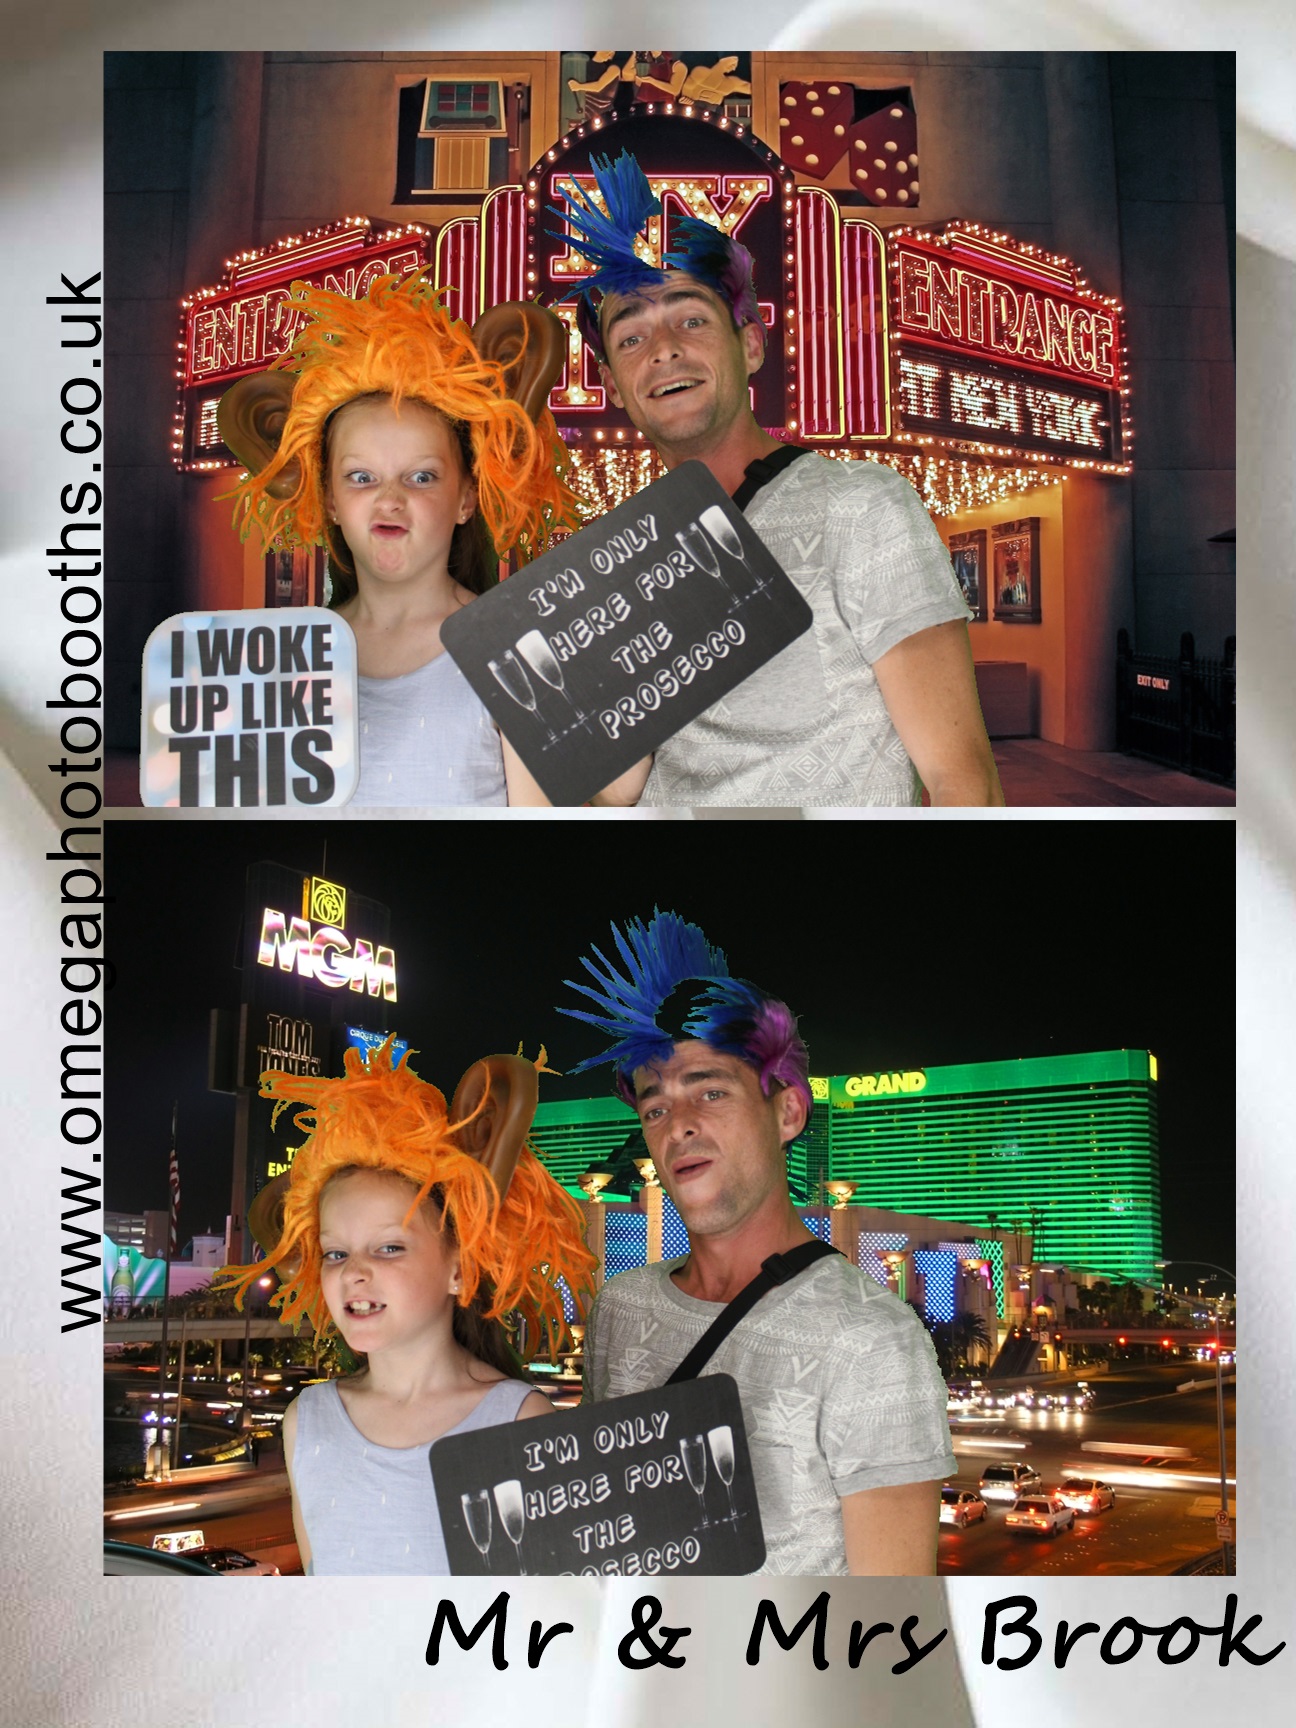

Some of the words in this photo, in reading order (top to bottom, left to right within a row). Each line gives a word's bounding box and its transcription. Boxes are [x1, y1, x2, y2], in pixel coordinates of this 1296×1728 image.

[191, 250, 418, 374] ENTRNC
[899, 251, 1114, 377] ENTRANCE
[529, 568, 586, 617] I'M
[590, 514, 659, 574] ONLY
[549, 592, 632, 663] HERE
[635, 550, 695, 601] FOR
[171, 630, 184, 678] I
[197, 624, 333, 678] WOKE
[611, 621, 673, 674] THE
[170, 684, 229, 734] UP
[242, 679, 333, 729] LIKE
[600, 619, 746, 740] PROSECCO
[1137, 674, 1152, 687] EXIT
[1151, 677, 1169, 690] ONLY
[168, 728, 336, 807] THIS
[257, 907, 397, 1003] MGM
[266, 1013, 313, 1056] TOM
[844, 1071, 927, 1097] GRAND
[524, 1434, 579, 1472] I'M
[594, 1411, 669, 1454] ONLY
[525, 1473, 611, 1520] HERE
[625, 1455, 684, 1493] FOR
[573, 1513, 636, 1554] THE
